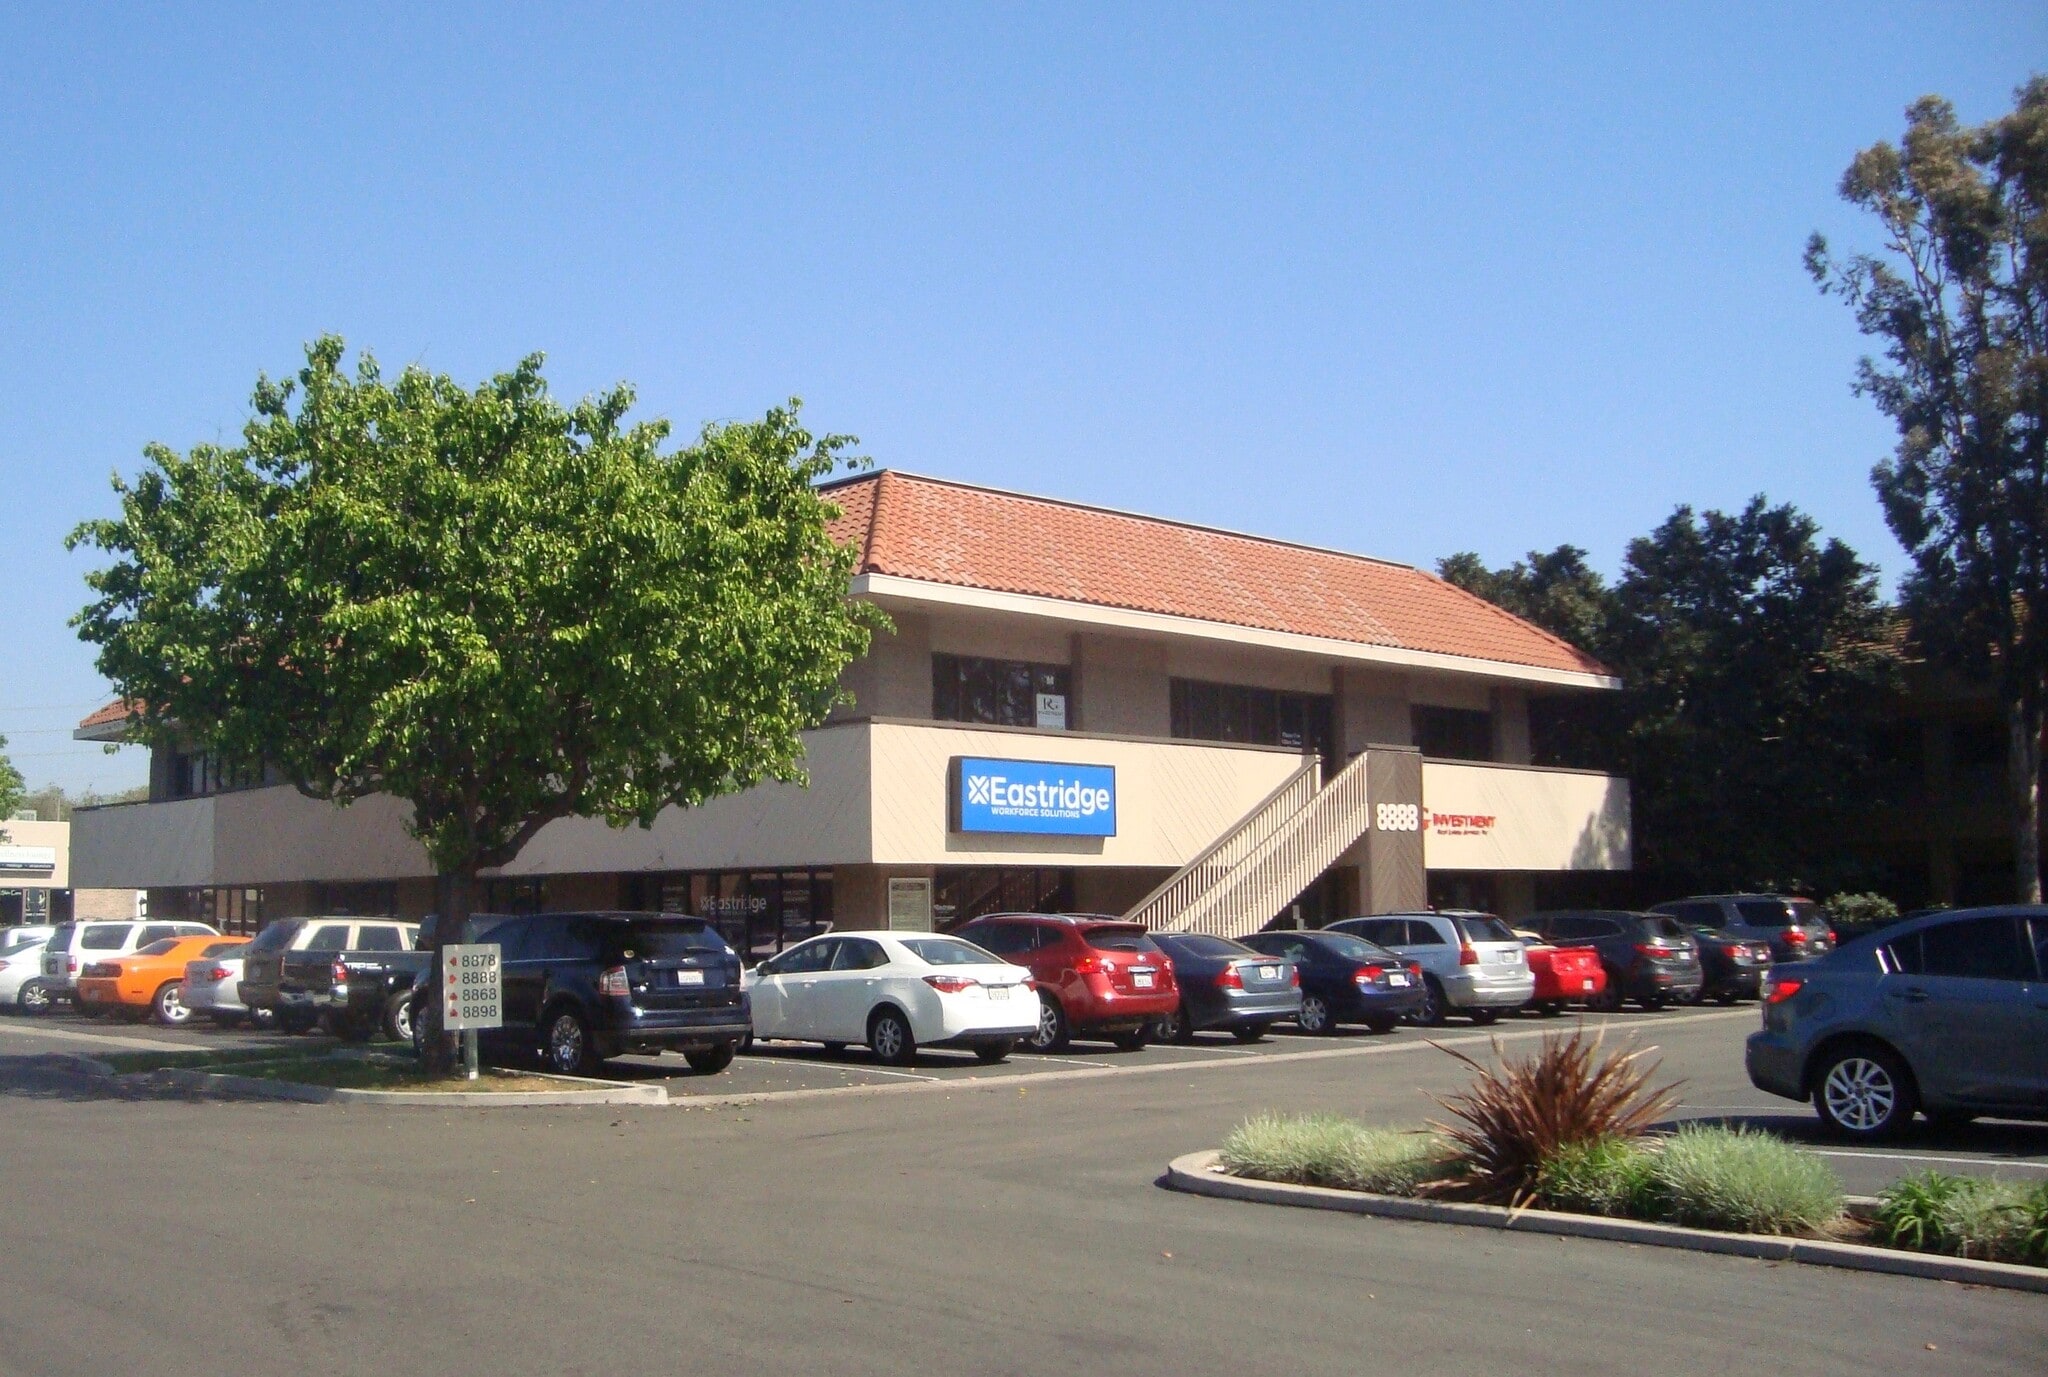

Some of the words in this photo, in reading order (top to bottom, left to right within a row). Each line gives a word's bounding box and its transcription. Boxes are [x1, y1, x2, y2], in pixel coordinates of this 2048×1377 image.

[990, 776, 1110, 816] Eastridge
[991, 807, 1039, 817] WORKFORCE
[1040, 808, 1080, 819] SOLUTIONS
[1376, 803, 1418, 831] 8888
[1433, 813, 1496, 828] INVESTMENT
[462, 954, 496, 967] 8878
[462, 971, 497, 984] 8888
[462, 988, 497, 1001] 8868
[463, 1005, 497, 1018] 8898
